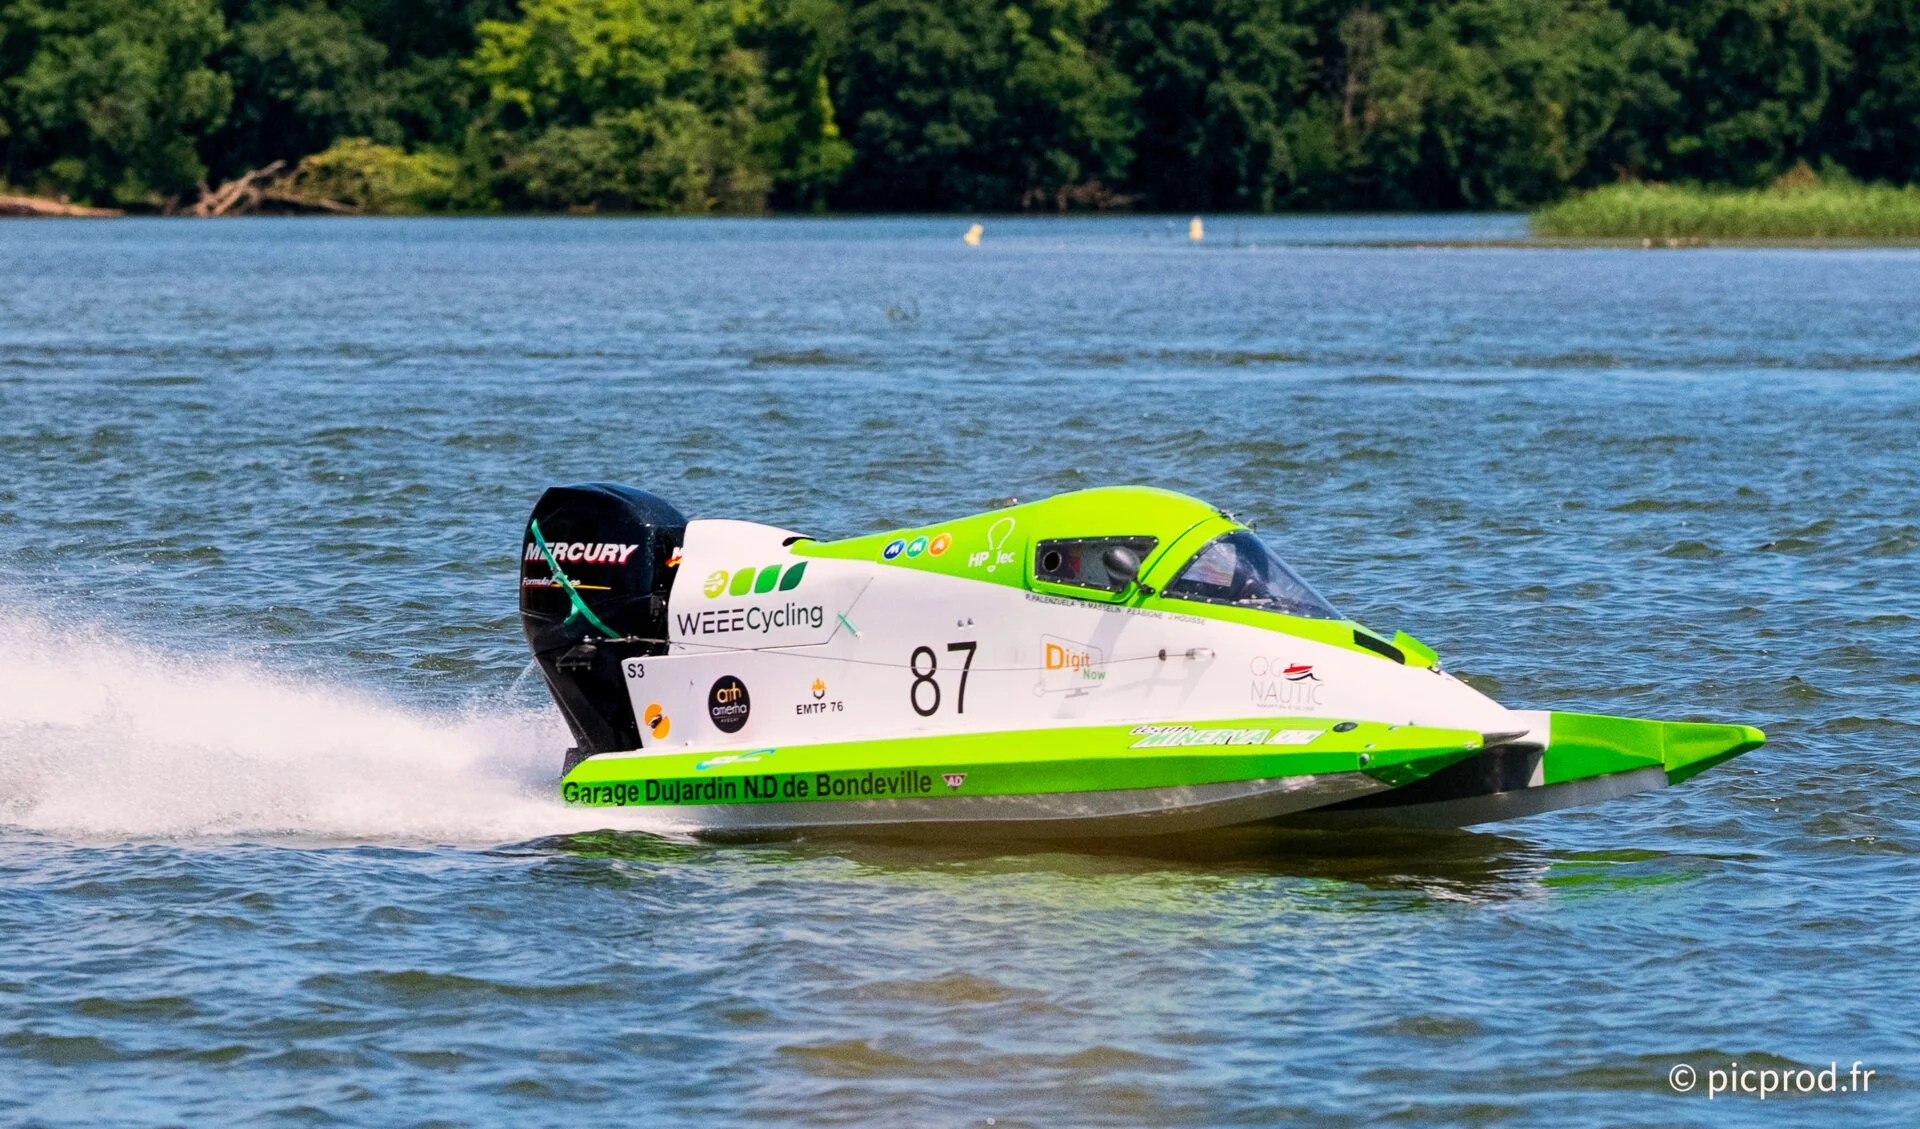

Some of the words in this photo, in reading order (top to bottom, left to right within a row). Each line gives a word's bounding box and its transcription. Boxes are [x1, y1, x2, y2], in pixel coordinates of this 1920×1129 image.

[677, 603, 824, 637] WEEECycling
[627, 663, 645, 679] S3
[1045, 643, 1090, 672] Digit
[910, 641, 977, 717] 87
[1083, 669, 1106, 680] Now
[1250, 680, 1324, 706] NAUTIC
[796, 703, 827, 716] EMTP
[831, 701, 844, 712] 76
[563, 780, 639, 807] Garage
[744, 775, 777, 800] N.D
[782, 774, 808, 797] de
[817, 771, 932, 797] Bondeville
